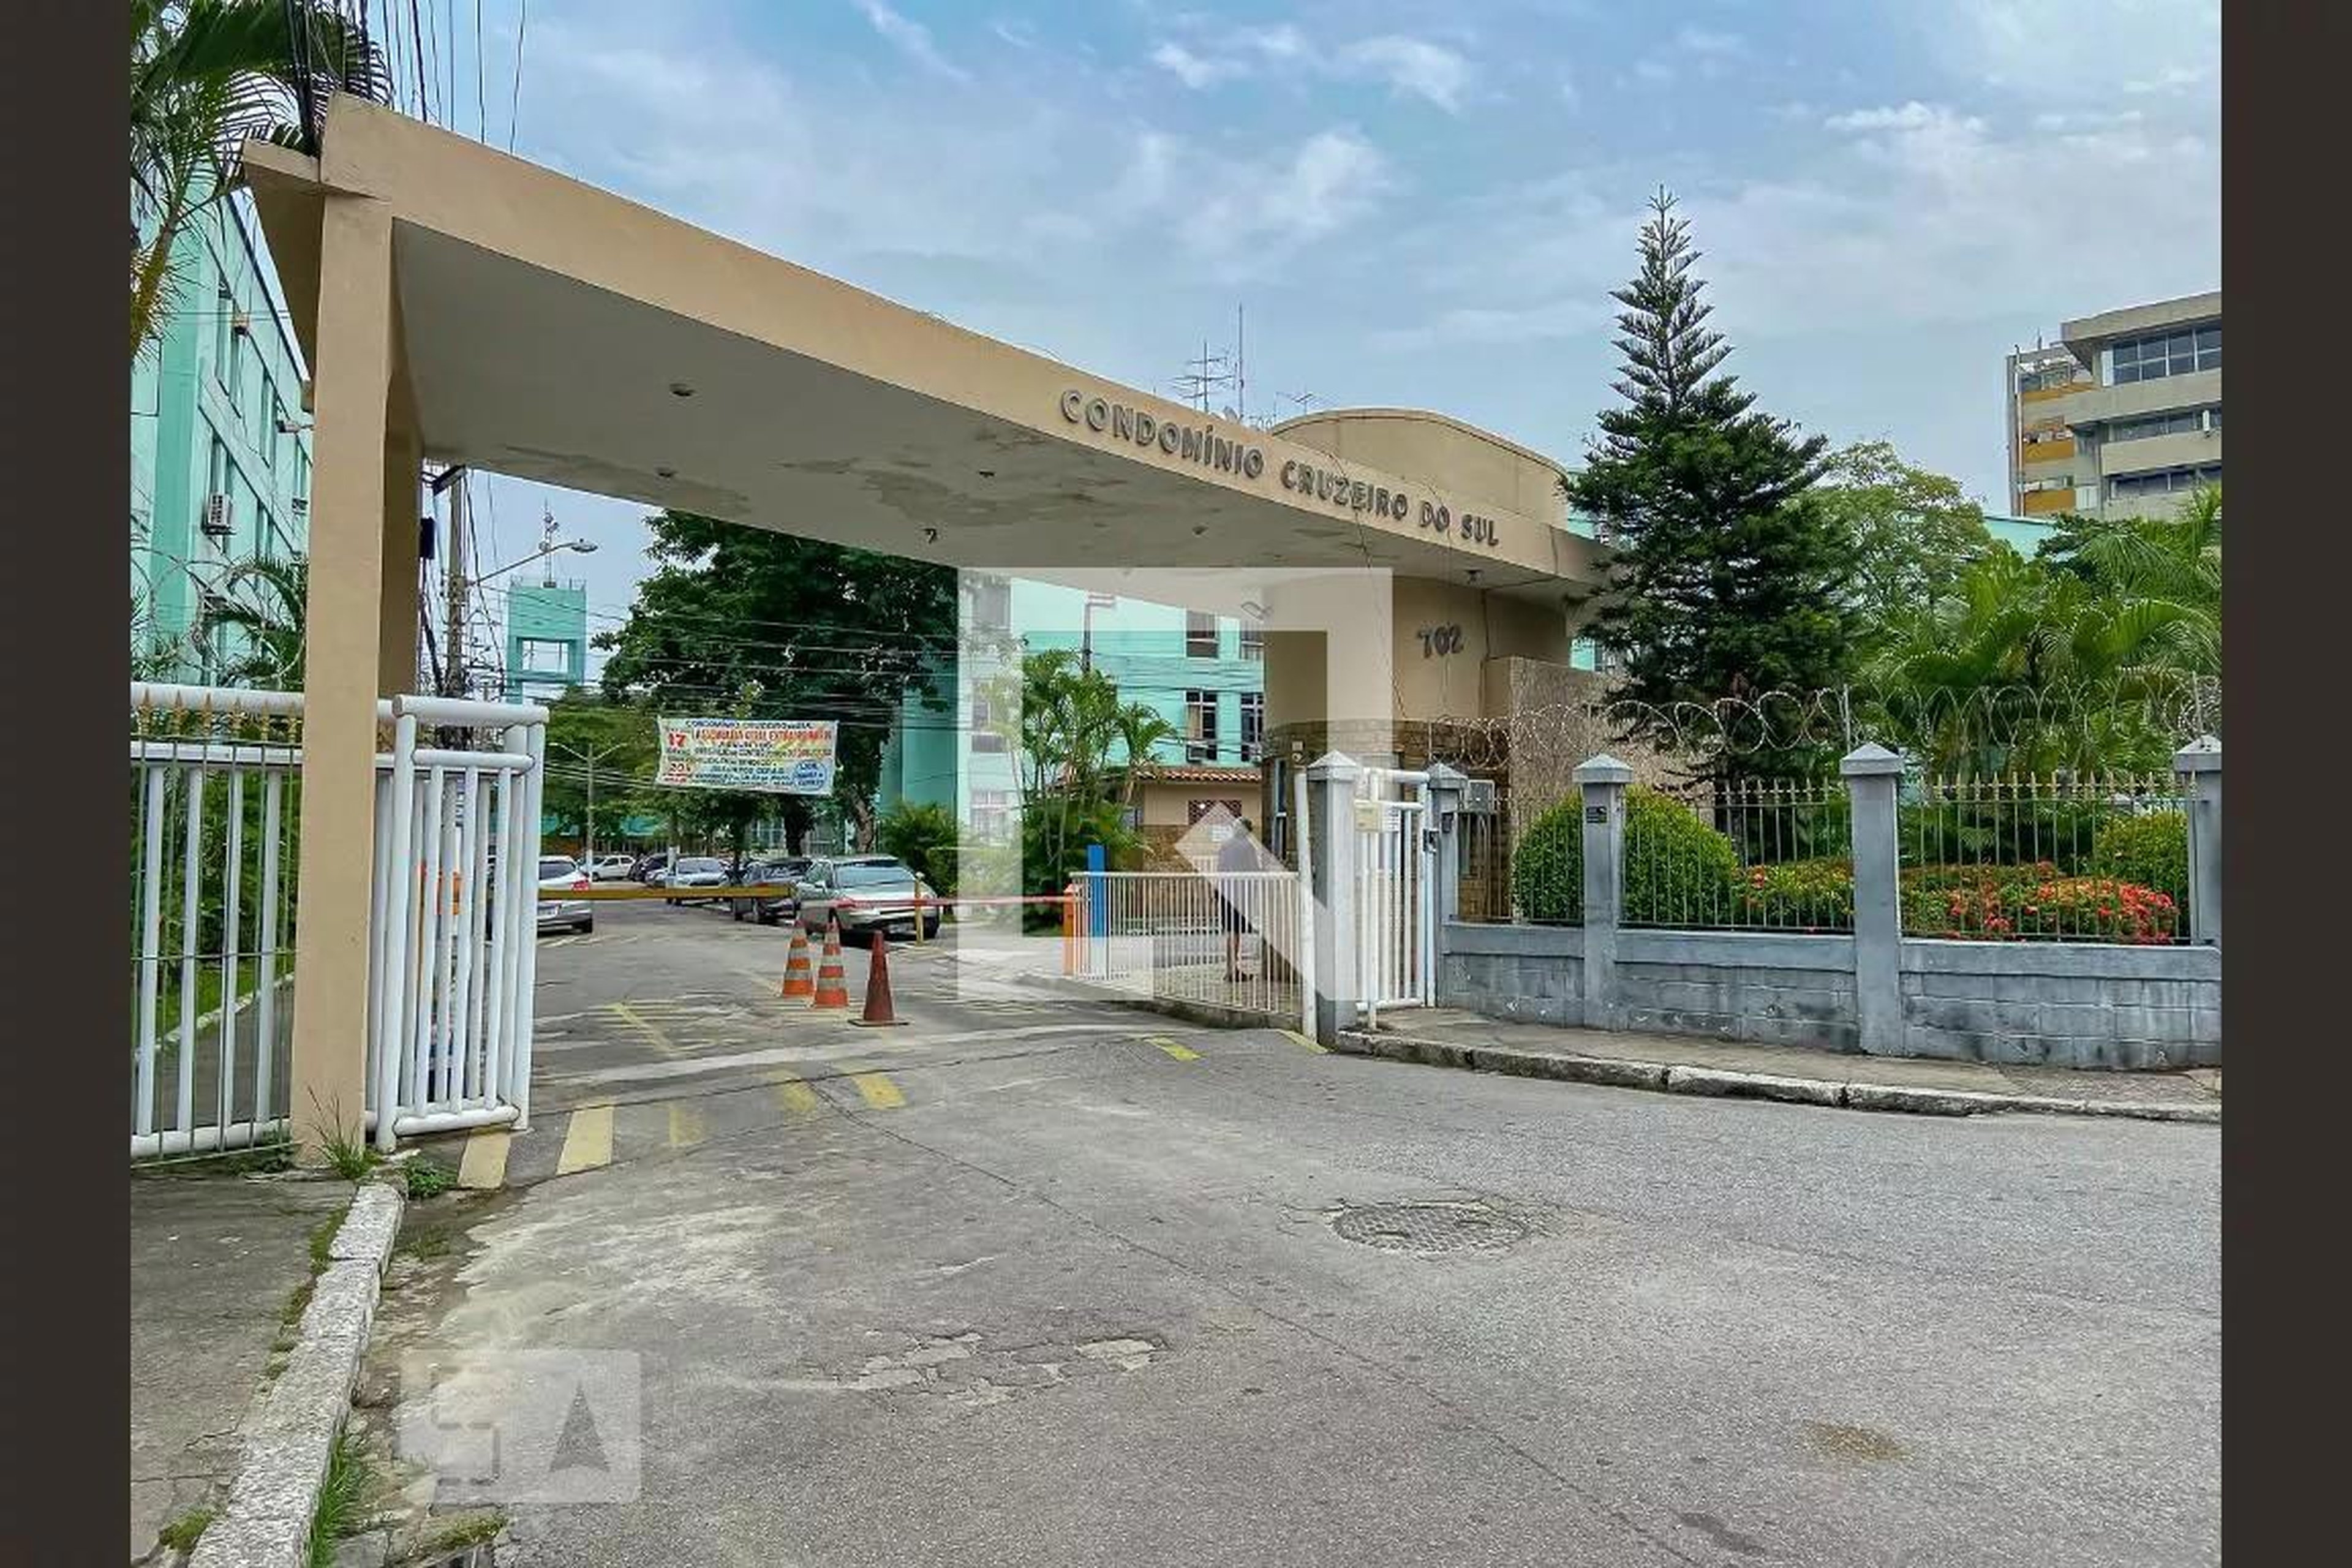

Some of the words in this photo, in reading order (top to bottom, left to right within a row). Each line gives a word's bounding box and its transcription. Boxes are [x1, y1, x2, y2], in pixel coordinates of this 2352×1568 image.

[1061, 390, 1264, 478] CONDOMÍNIO
[1280, 460, 1408, 520] CRUZEIRO
[1419, 501, 1450, 532] DO
[1461, 513, 1499, 546] SUL
[1417, 624, 1464, 658] 702
